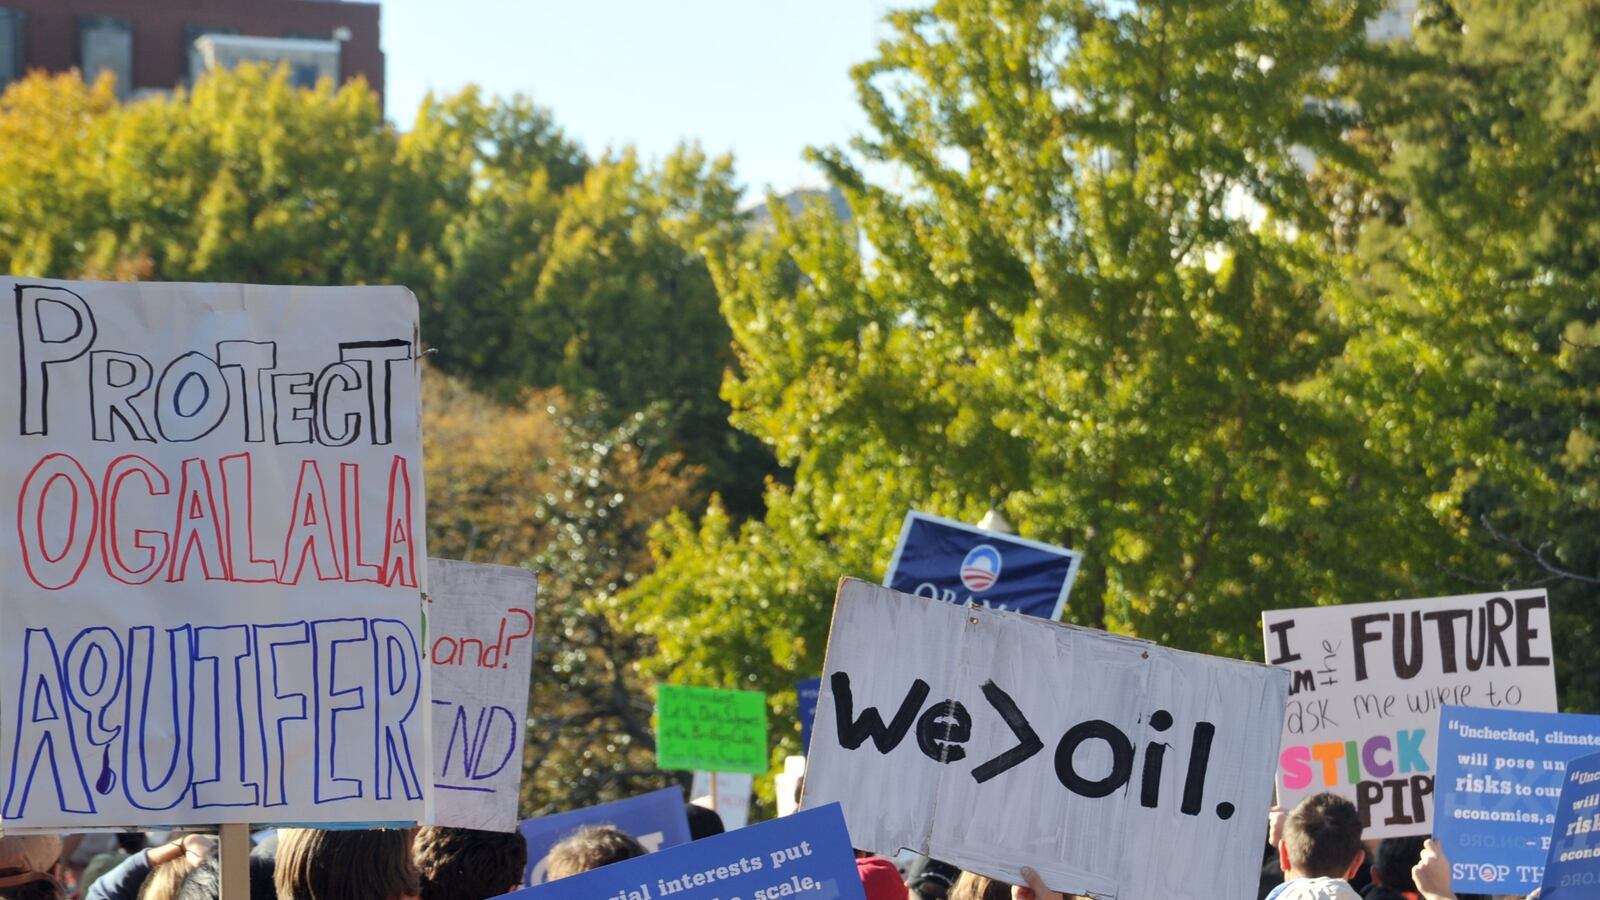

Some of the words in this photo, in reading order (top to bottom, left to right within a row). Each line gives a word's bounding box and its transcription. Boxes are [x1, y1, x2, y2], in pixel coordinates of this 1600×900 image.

[15, 284, 412, 446] PROTECT
[18, 452, 417, 590] OGALALA
[1269, 619, 1302, 665] I
[1351, 596, 1550, 681] FUTURE
[2, 618, 423, 819] AQUIFER
[1287, 698, 1339, 734] ask
[1486, 682, 1522, 706] to
[1280, 729, 1431, 790] STICK
[1456, 774, 1511, 795] risks
[1515, 785, 1531, 796] to
[1457, 753, 1488, 767] will
[1495, 757, 1535, 769] pose
[1357, 775, 1434, 829] PIP
[1454, 809, 1543, 824] economies,
[1572, 794, 1599, 811] will
[657, 855, 763, 897] interests
[770, 840, 813, 868] put
[1452, 863, 1510, 882] STOP
